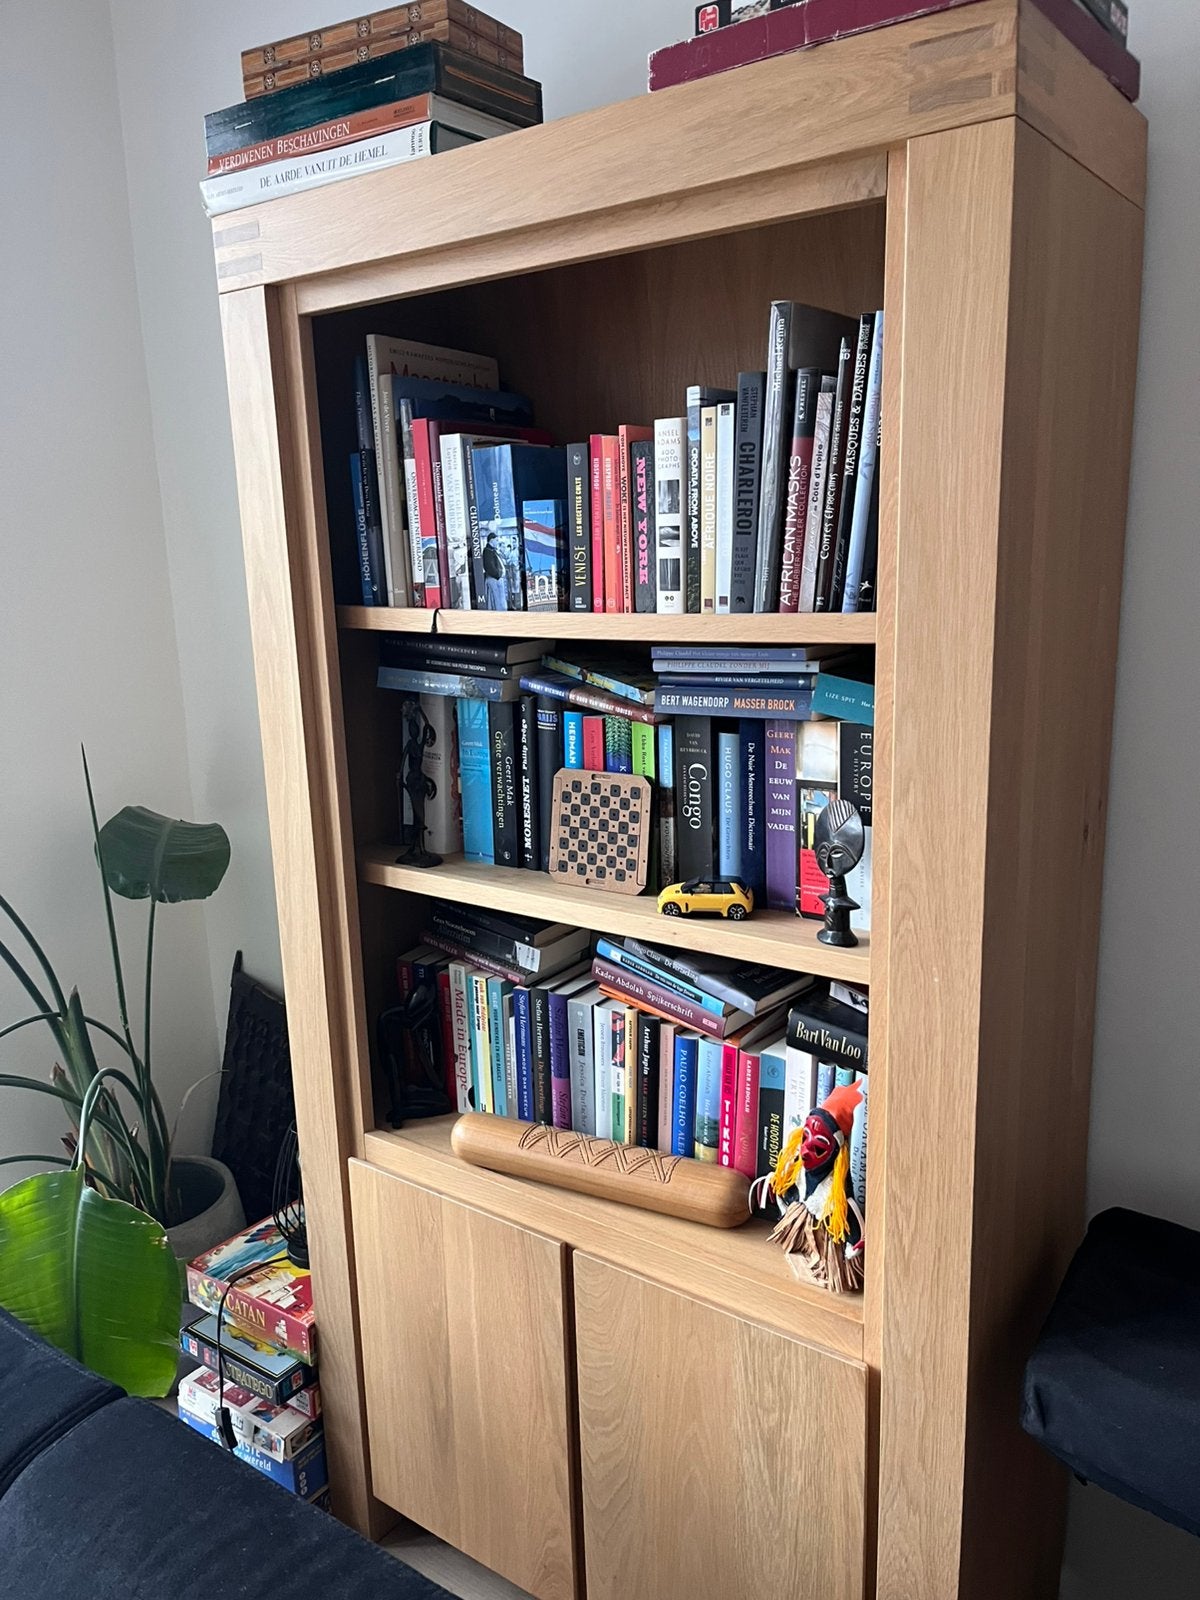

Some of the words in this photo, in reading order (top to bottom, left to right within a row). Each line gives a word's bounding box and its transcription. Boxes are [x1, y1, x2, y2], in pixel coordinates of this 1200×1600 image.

[219, 143, 274, 171] VERDWENEN
[277, 122, 351, 156] BESCHAVINGEN
[259, 176, 272, 190] DE
[274, 168, 303, 187] AARDE
[305, 158, 337, 181] VANUIT
[339, 153, 353, 168] DE
[354, 144, 389, 165] HEMEL
[775, 318, 785, 352] Kenna
[853, 353, 867, 402] DANSES
[799, 379, 807, 415] PRESTEL
[850, 404, 861, 414] &
[657, 429, 680, 438] ANSEL
[657, 438, 681, 446] ADAMS
[845, 417, 860, 476] MASQUES
[592, 457, 600, 491] KIDSPROOF
[604, 457, 612, 490] KIDSPROOF
[690, 447, 699, 487] CROATIA
[704, 452, 715, 492] NOIRE
[574, 477, 582, 495] CULTE
[636, 456, 648, 513] NEW
[690, 488, 699, 515] FROM
[736, 441, 757, 536] CHARLEROI
[786, 455, 802, 523] MASKS
[447, 494, 457, 537] LIMBURG
[575, 495, 583, 525] RECETTES
[703, 493, 716, 549] AFRIQUE
[793, 518, 805, 590] BARBIER-MUELLER
[799, 464, 808, 516] COLLECTION
[469, 505, 481, 559] CHANSONS!
[575, 525, 583, 536] LES
[690, 517, 699, 548] ABOVE
[573, 545, 587, 587] VENISE
[638, 518, 649, 585] YORK
[780, 527, 796, 606] AFRICAN
[661, 695, 680, 706] BERT
[682, 695, 730, 708] WAGENDORP
[734, 699, 766, 710] MASSER
[767, 699, 795, 711] BROCK
[825, 691, 840, 700] LIZE
[841, 695, 856, 704] SPIT
[495, 731, 503, 760] Grote
[568, 721, 577, 764] HERMAN
[747, 742, 755, 753] De
[724, 747, 732, 778] HUGO
[859, 732, 872, 814] EUROPE
[496, 760, 505, 829] verwachtingen
[682, 762, 708, 830] Congo
[769, 777, 793, 785] EEUW
[772, 793, 790, 801] VAN
[522, 775, 532, 850] MORESNET
[767, 823, 795, 832] VADER
[771, 808, 792, 816] MIJN
[631, 942, 647, 956] Hugo
[455, 989, 467, 1025] Made
[518, 994, 526, 1015] Stefan
[594, 966, 615, 981] Kader
[615, 974, 644, 996] Abdolah
[646, 990, 694, 1019] Spijkerschrift
[457, 1030, 466, 1041] in
[519, 1015, 527, 1047] Hertmans
[536, 1022, 544, 1058] Hertmans
[643, 1026, 651, 1053] Arthur
[796, 1020, 819, 1044] Bart
[819, 1027, 841, 1053] Van
[840, 1038, 861, 1060] Loo
[455, 1044, 468, 1091] Europe
[578, 1060, 587, 1088] Jessica
[643, 1052, 651, 1075] Japin
[678, 1049, 688, 1083] PAULO
[558, 1091, 569, 1118] Stefan
[744, 1082, 752, 1113] ABDOLAH
[790, 1079, 798, 1096] FRY
[797, 1069, 806, 1111] STEPHEN
[678, 1084, 688, 1127] COELHO
[770, 1113, 780, 1123] DE
[677, 1129, 686, 1155] ALEP
[768, 1124, 780, 1168] HOOFDSTAD
[226, 1293, 266, 1327] CATAN
[225, 1361, 273, 1399] STRATEGO
[244, 1453, 272, 1472] wereld
